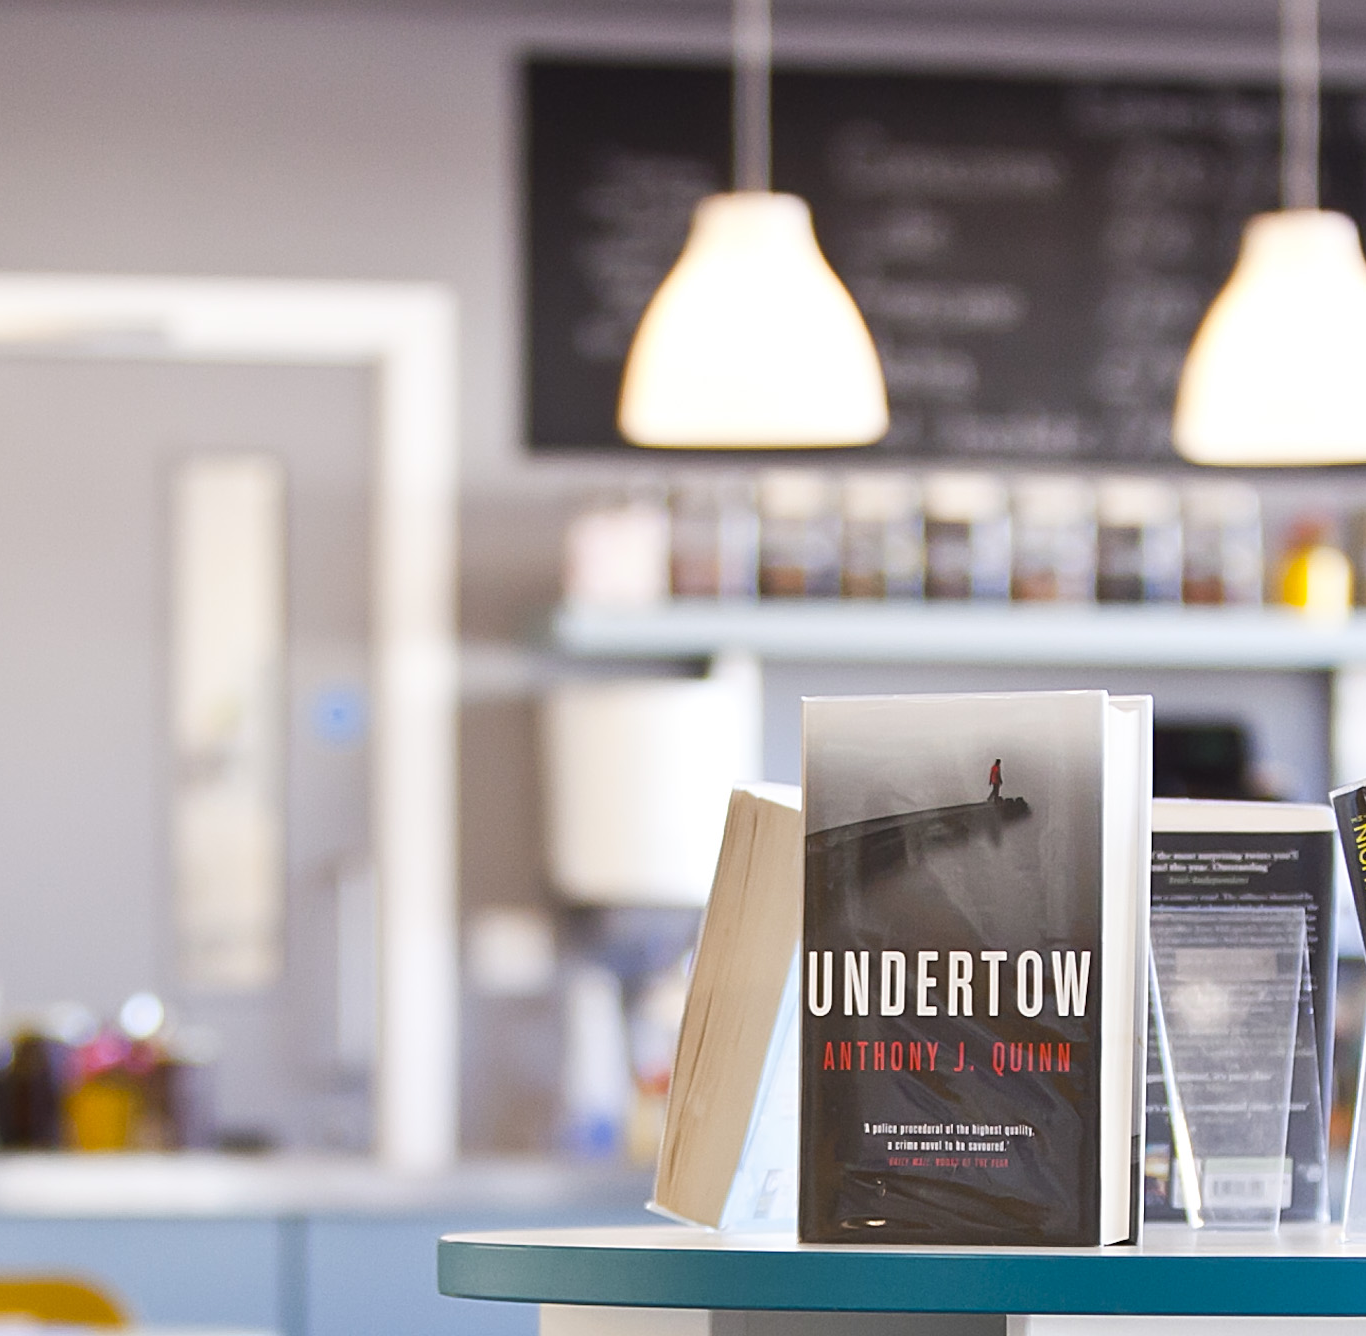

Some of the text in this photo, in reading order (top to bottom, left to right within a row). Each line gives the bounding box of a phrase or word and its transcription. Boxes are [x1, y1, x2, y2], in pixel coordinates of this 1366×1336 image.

[808, 951, 1091, 1017] UNDERTOW
[823, 1041, 1072, 1076] ANTHONY J. QUINN
[872, 1123, 898, 1136] police
[900, 1123, 943, 1135] procedural
[956, 1123, 970, 1135] the
[972, 1124, 1002, 1137] highest
[887, 1141, 893, 1150] a
[895, 1140, 919, 1150] crime
[920, 1140, 942, 1151] novel
[944, 1141, 953, 1151] to
[955, 1141, 966, 1151] be
